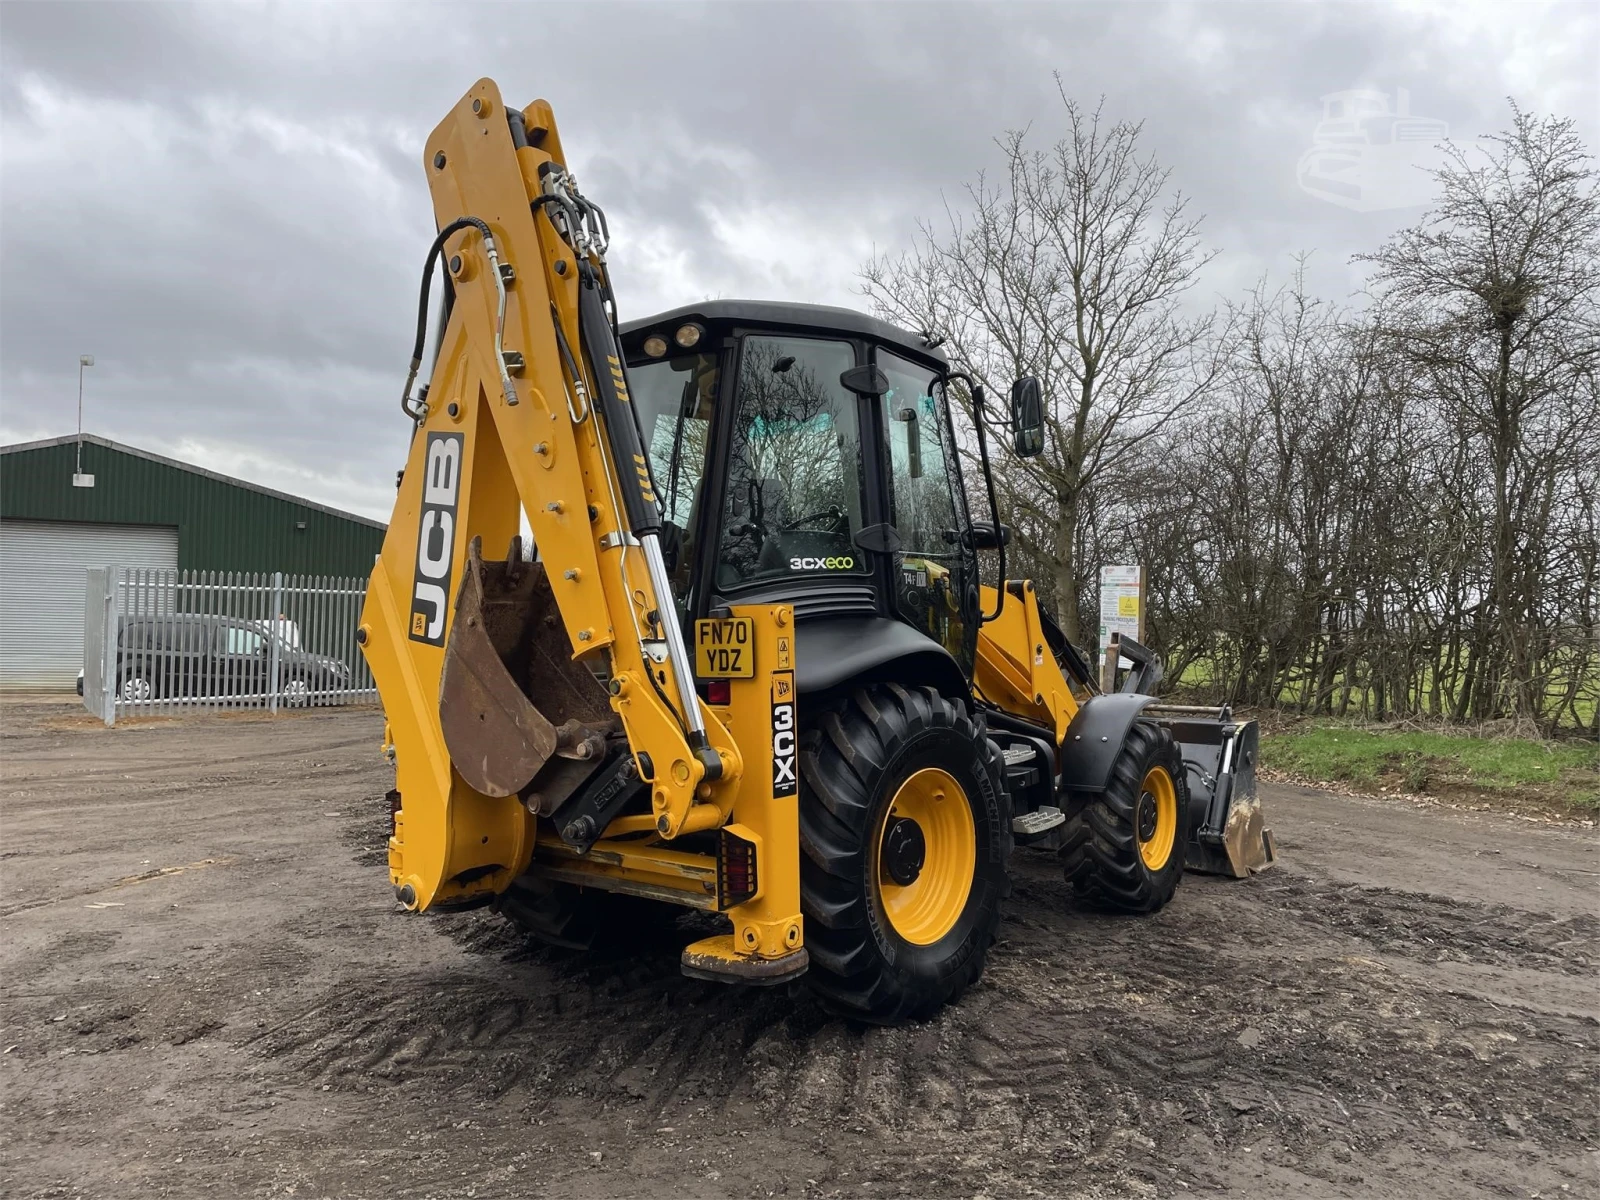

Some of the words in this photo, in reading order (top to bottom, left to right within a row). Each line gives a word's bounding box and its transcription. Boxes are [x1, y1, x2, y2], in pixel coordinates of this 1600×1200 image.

[415, 437, 460, 640] JCB
[700, 621, 747, 645] FN70
[706, 648, 742, 672] YDZ
[777, 681, 790, 696] JCB
[774, 705, 796, 783] 3CX
